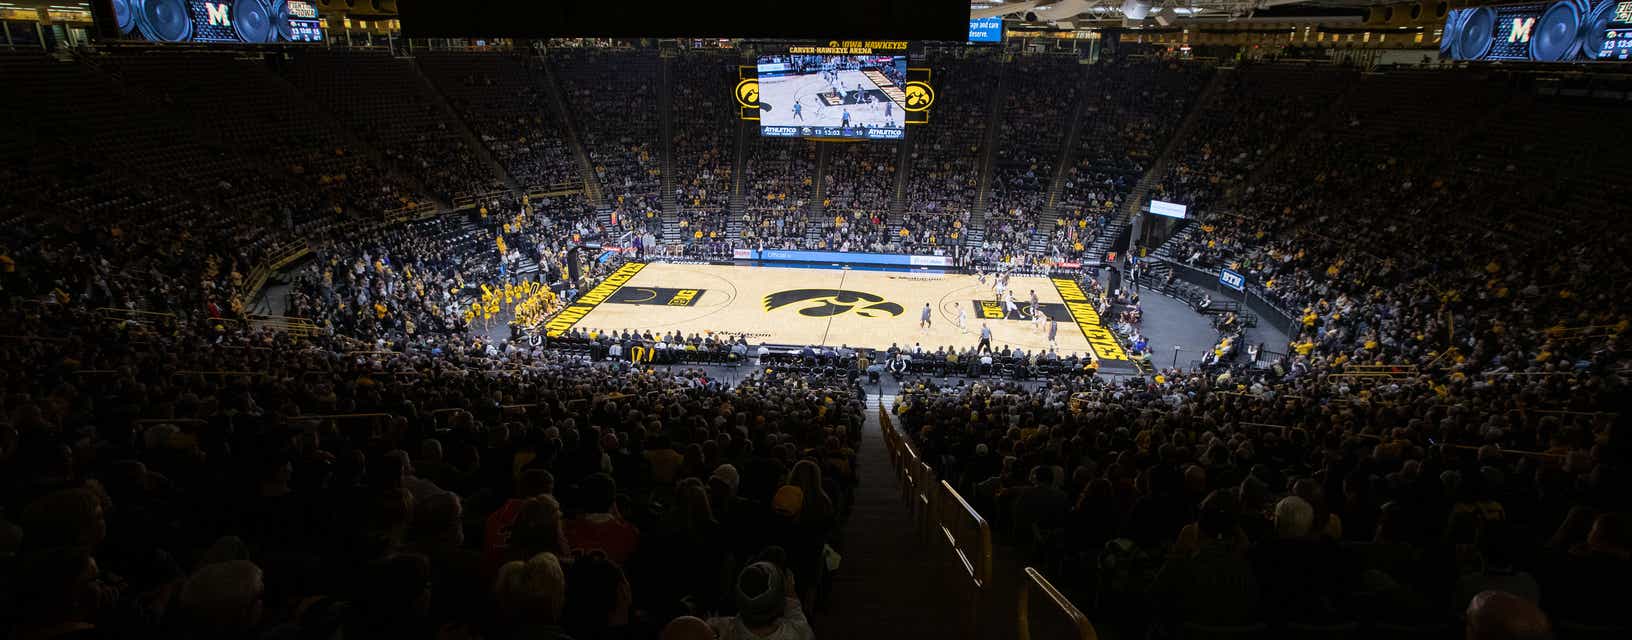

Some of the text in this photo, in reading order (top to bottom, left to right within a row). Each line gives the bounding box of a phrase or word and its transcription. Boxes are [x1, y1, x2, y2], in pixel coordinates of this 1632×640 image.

[205, 2, 231, 26] M
[1508, 17, 1536, 43] M
[865, 41, 908, 49] HAWKEYES
